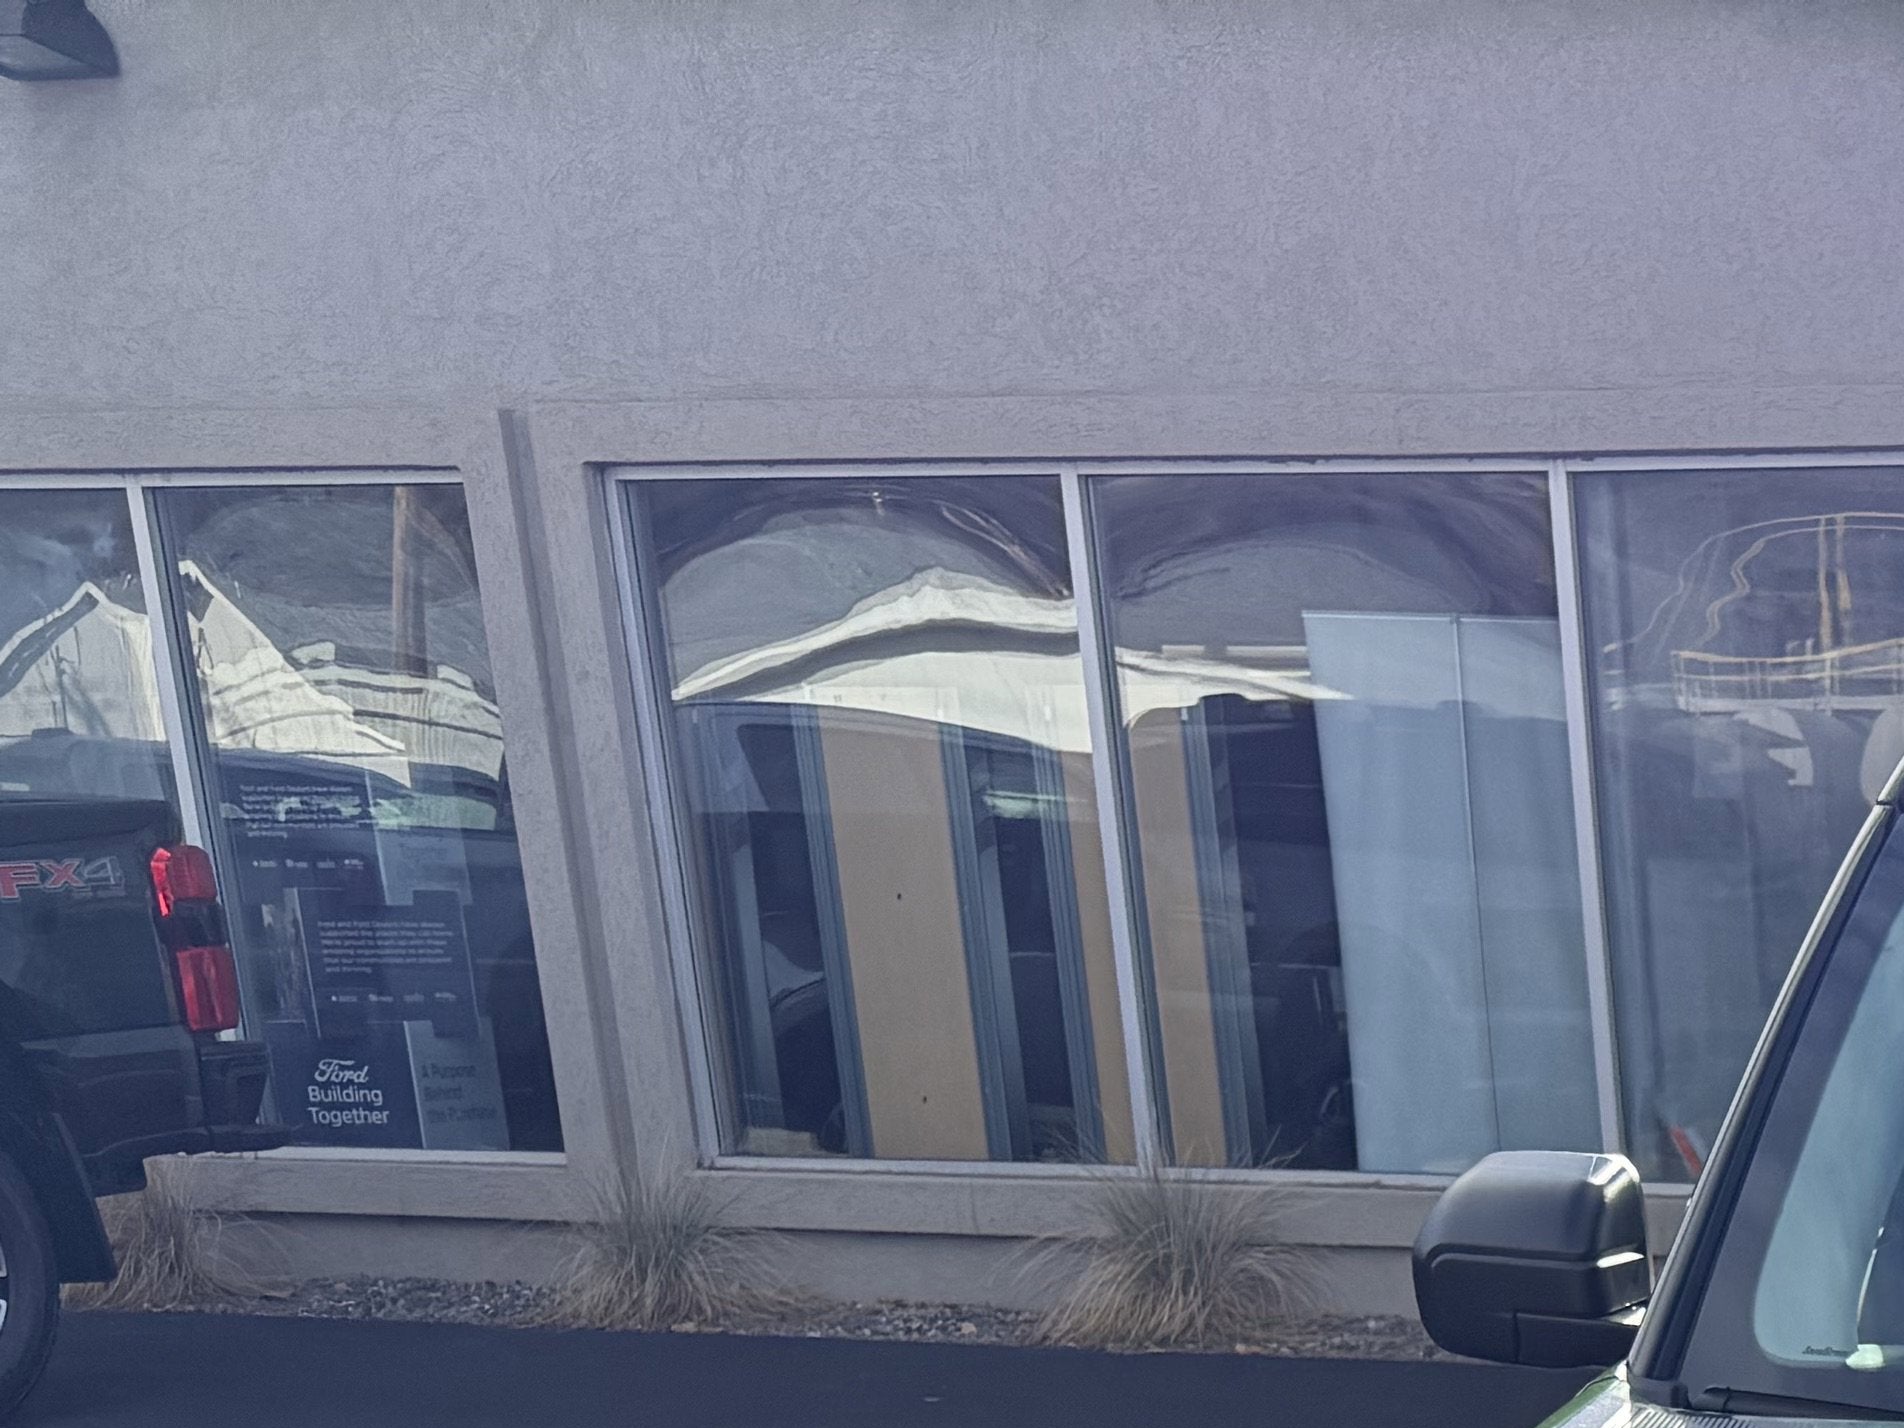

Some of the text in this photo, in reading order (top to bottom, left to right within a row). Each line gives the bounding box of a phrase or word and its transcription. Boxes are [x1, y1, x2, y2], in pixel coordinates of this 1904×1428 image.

[0, 856, 124, 902] FX4
[314, 1059, 369, 1083] Ford
[307, 1085, 384, 1106] Building
[307, 1107, 390, 1128] Together
